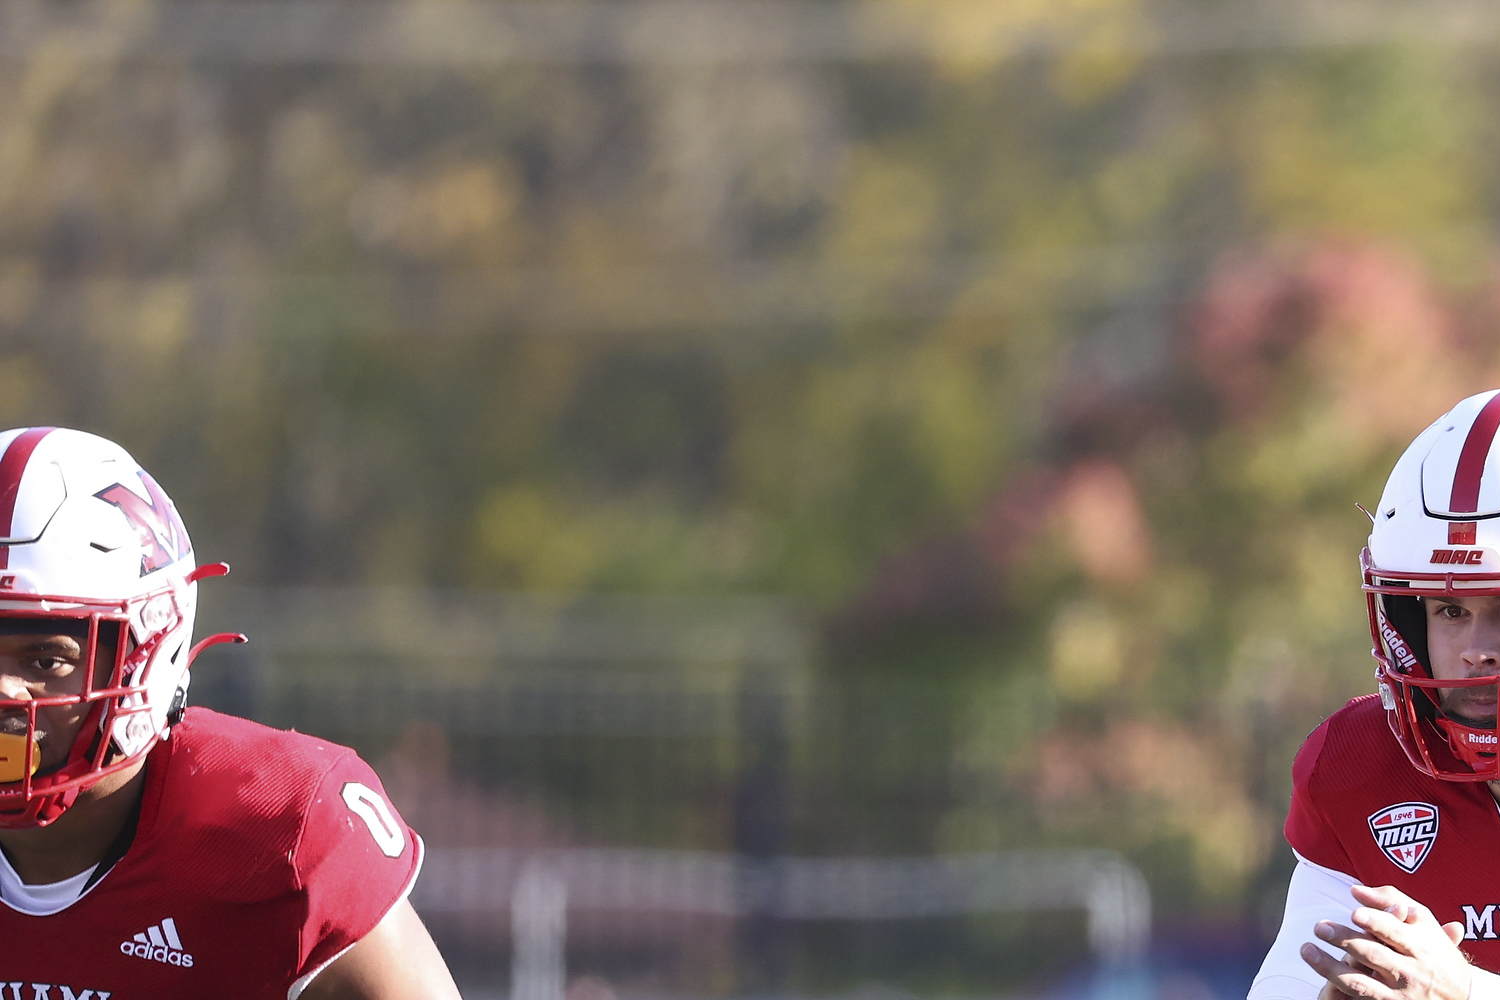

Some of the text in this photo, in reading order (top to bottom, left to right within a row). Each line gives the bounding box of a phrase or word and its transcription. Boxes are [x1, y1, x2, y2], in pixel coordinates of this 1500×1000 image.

[92, 470, 192, 579] M
[1430, 549, 1483, 565] MAC
[341, 782, 405, 859] 0
[1394, 811, 1413, 821] 1946
[1378, 821, 1436, 847] MAC
[120, 940, 194, 967] adidas
